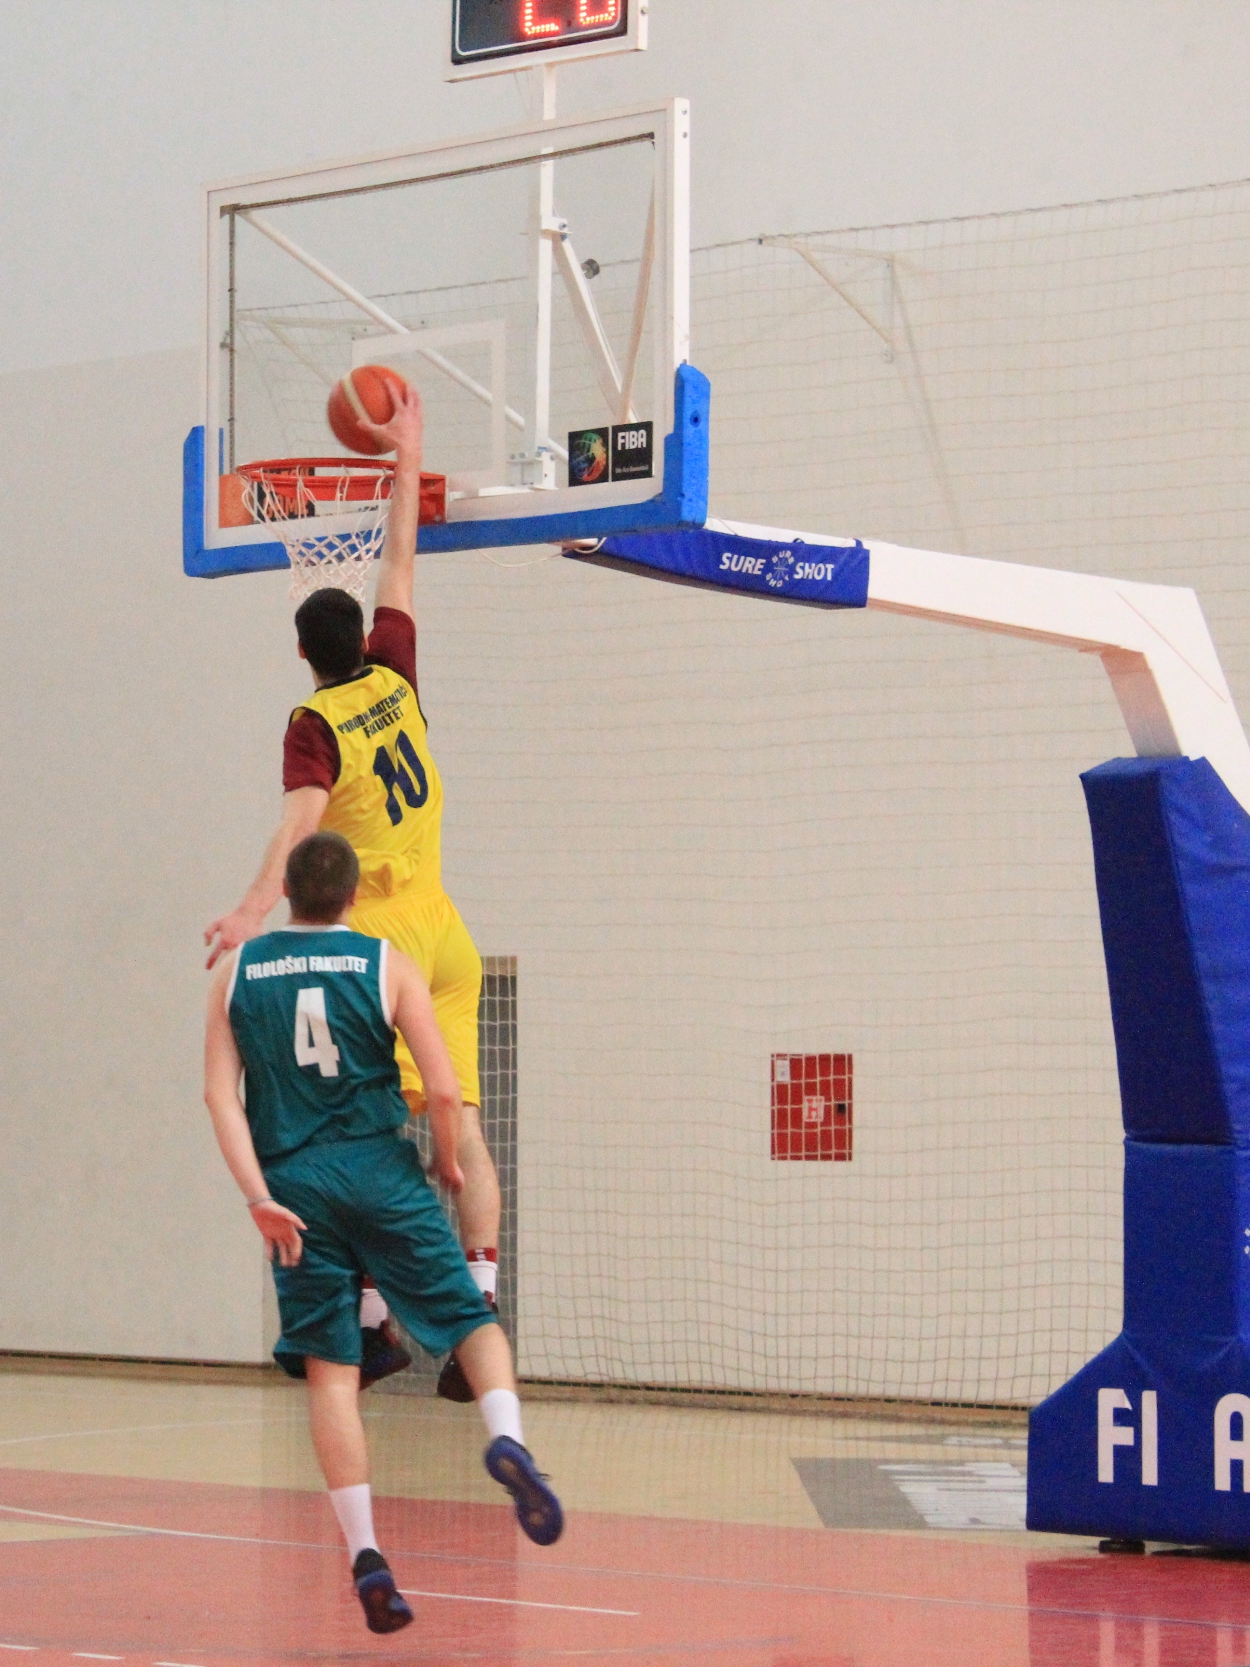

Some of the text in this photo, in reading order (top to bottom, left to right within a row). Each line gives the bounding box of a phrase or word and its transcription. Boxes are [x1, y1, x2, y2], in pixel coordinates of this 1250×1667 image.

[617, 429, 647, 451] FIBA
[719, 552, 835, 581] SURE SHOT
[372, 729, 429, 827] 10
[245, 955, 369, 981] FILOLOŠKI FAKULTET
[293, 986, 341, 1078] 4
